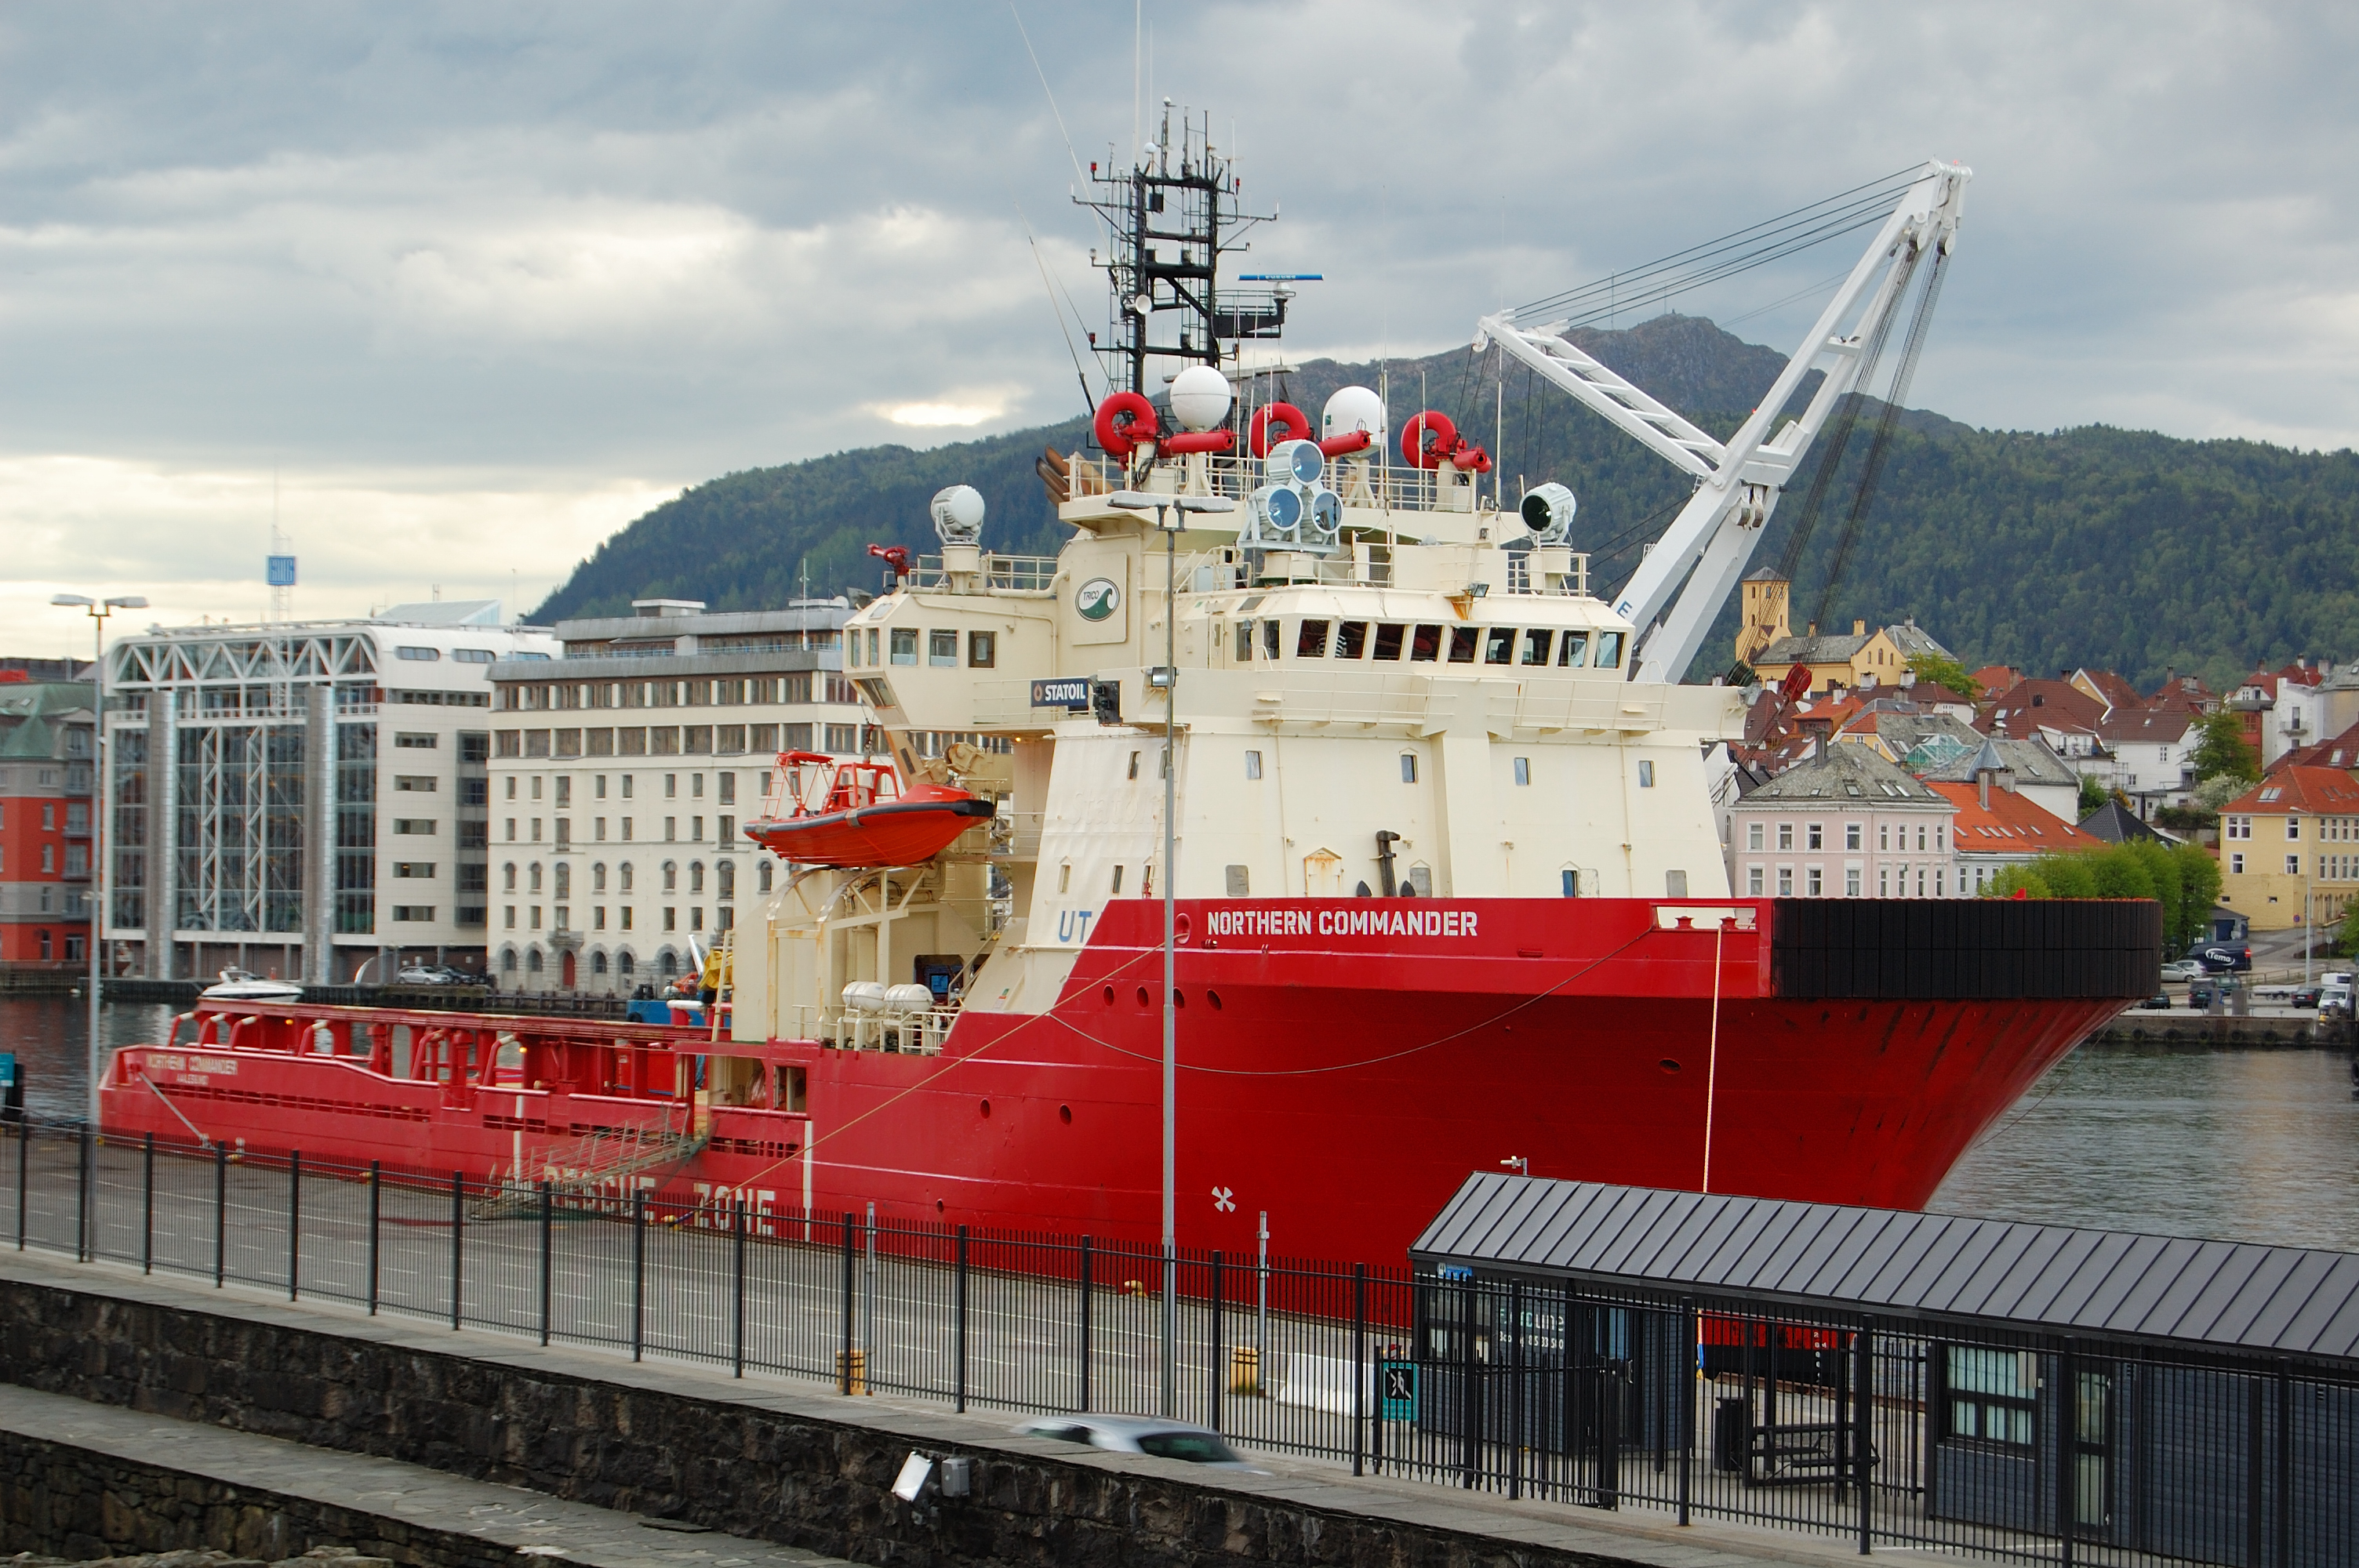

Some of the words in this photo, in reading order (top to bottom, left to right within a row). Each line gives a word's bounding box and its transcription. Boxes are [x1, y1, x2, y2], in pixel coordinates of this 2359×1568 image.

[1083, 590, 1100, 601] TRICO
[1045, 684, 1085, 701] STATOIL
[1059, 910, 1092, 942] UT
[1207, 910, 1312, 936] NORTHERN
[1318, 910, 1478, 937] COMMANDER
[2209, 951, 2232, 963] Tema
[693, 1181, 776, 1236] ZONE
